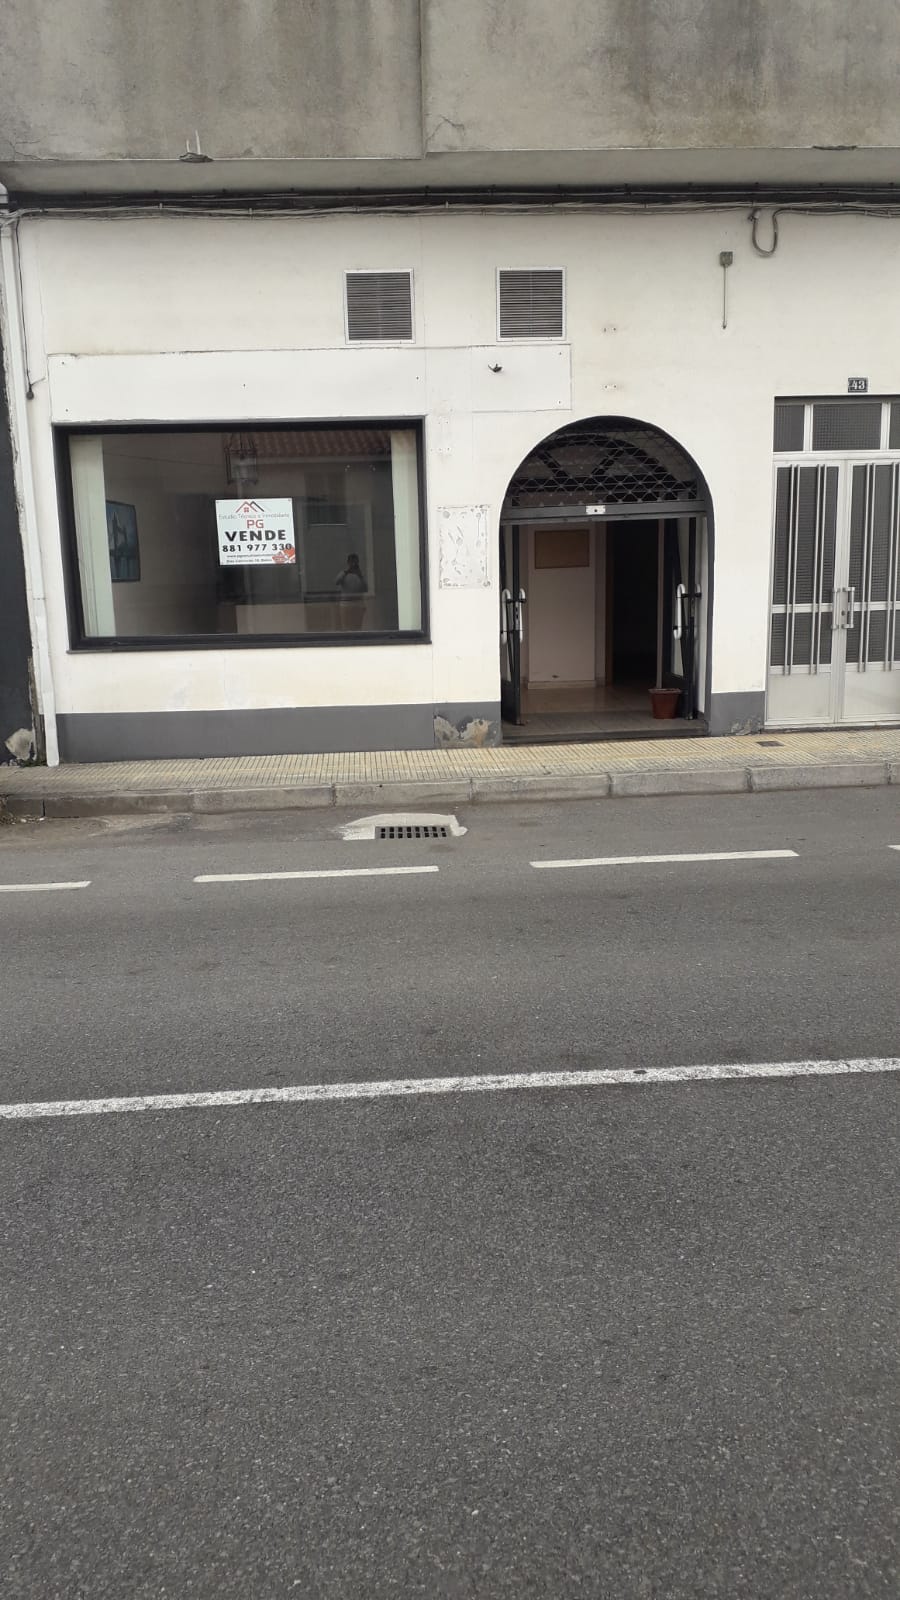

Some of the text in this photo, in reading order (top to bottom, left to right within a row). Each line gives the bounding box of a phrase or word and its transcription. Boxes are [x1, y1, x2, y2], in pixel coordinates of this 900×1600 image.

[847, 380, 865, 390] 43
[247, 519, 264, 528] PG
[225, 530, 286, 541] VENDE
[247, 543, 267, 551] 977
[272, 543, 292, 551] 330
